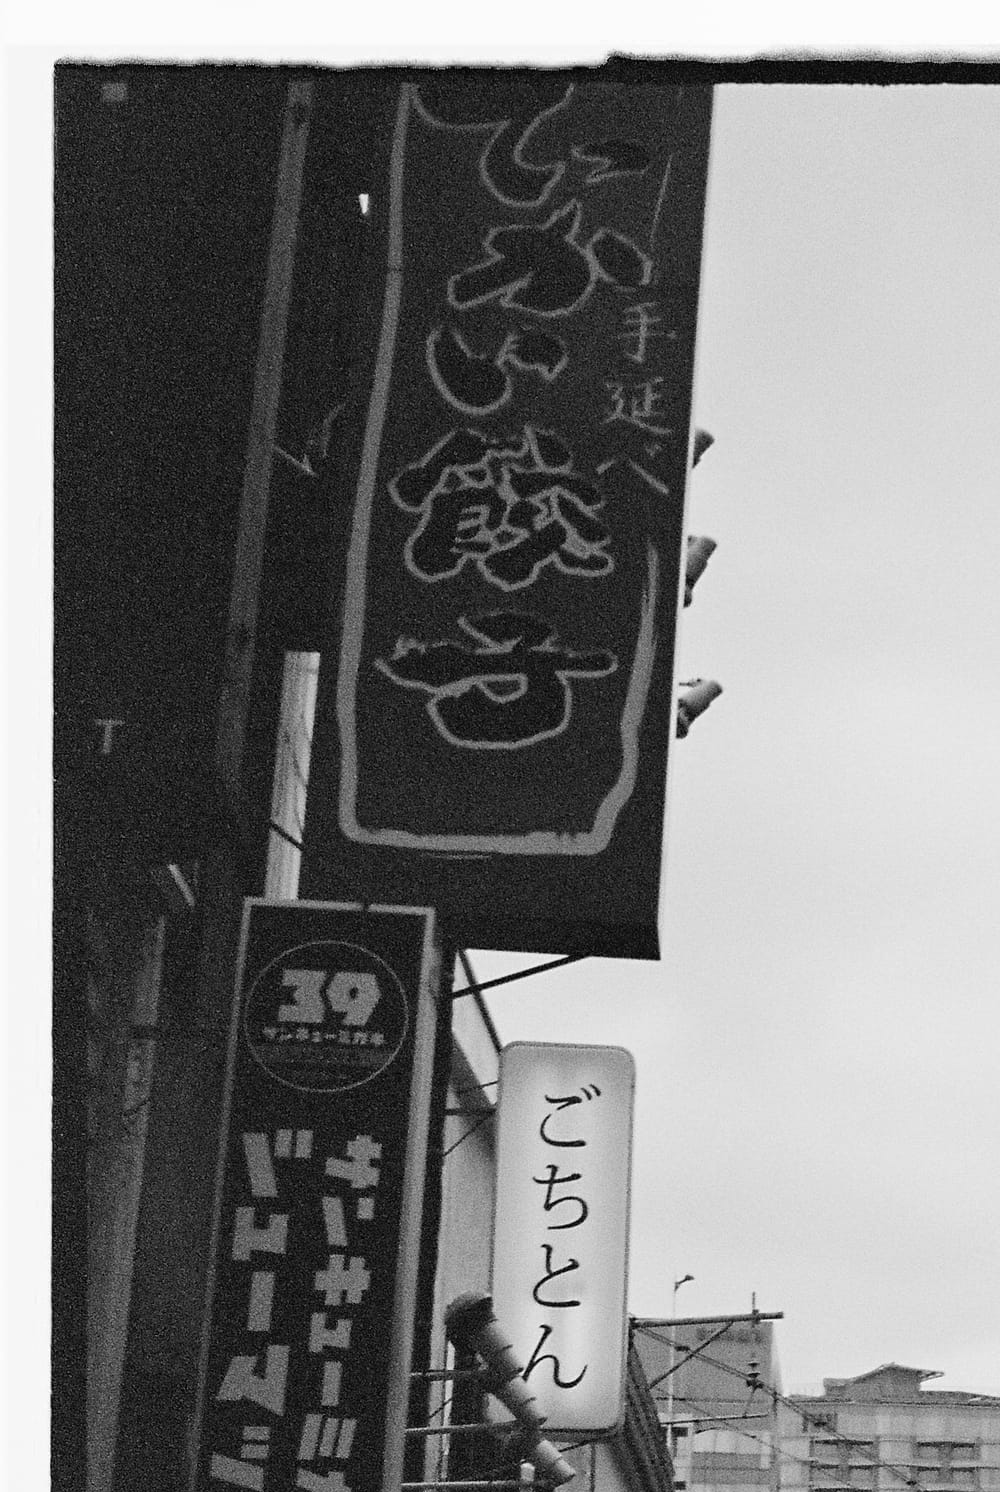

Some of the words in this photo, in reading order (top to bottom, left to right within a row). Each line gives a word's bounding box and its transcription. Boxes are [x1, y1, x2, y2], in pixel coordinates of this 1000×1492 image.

[595, 302, 676, 496] 手延べ
[277, 969, 382, 1025] 39
[521, 1082, 601, 1390] ごちとん
